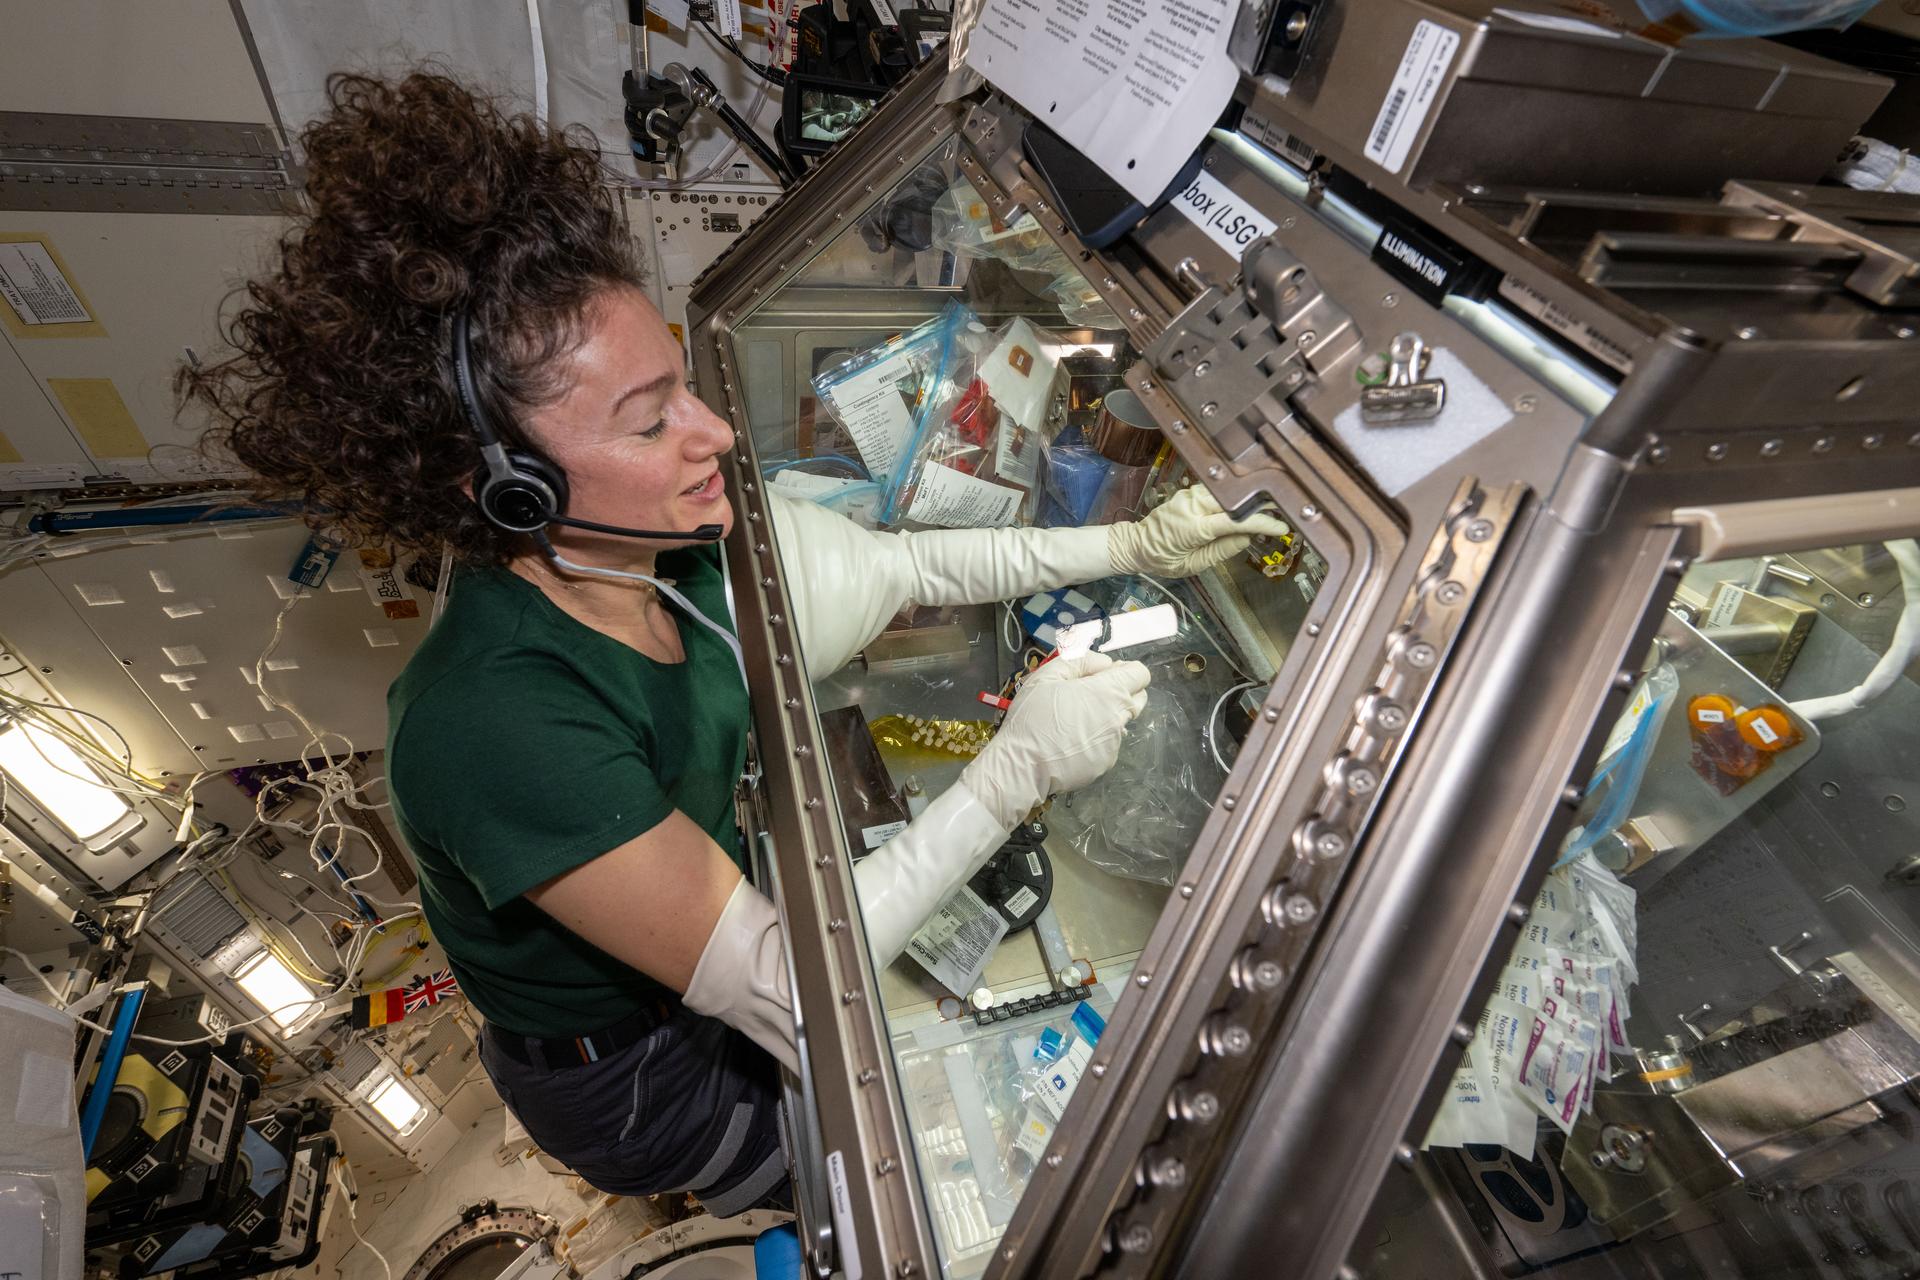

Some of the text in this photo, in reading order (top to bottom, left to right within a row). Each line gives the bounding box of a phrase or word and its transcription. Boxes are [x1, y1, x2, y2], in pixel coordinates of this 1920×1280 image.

[1182, 181, 1216, 214] box
[1380, 231, 1448, 287] ILLUMINATION
[1492, 1015, 1508, 1072] Non-Woven
